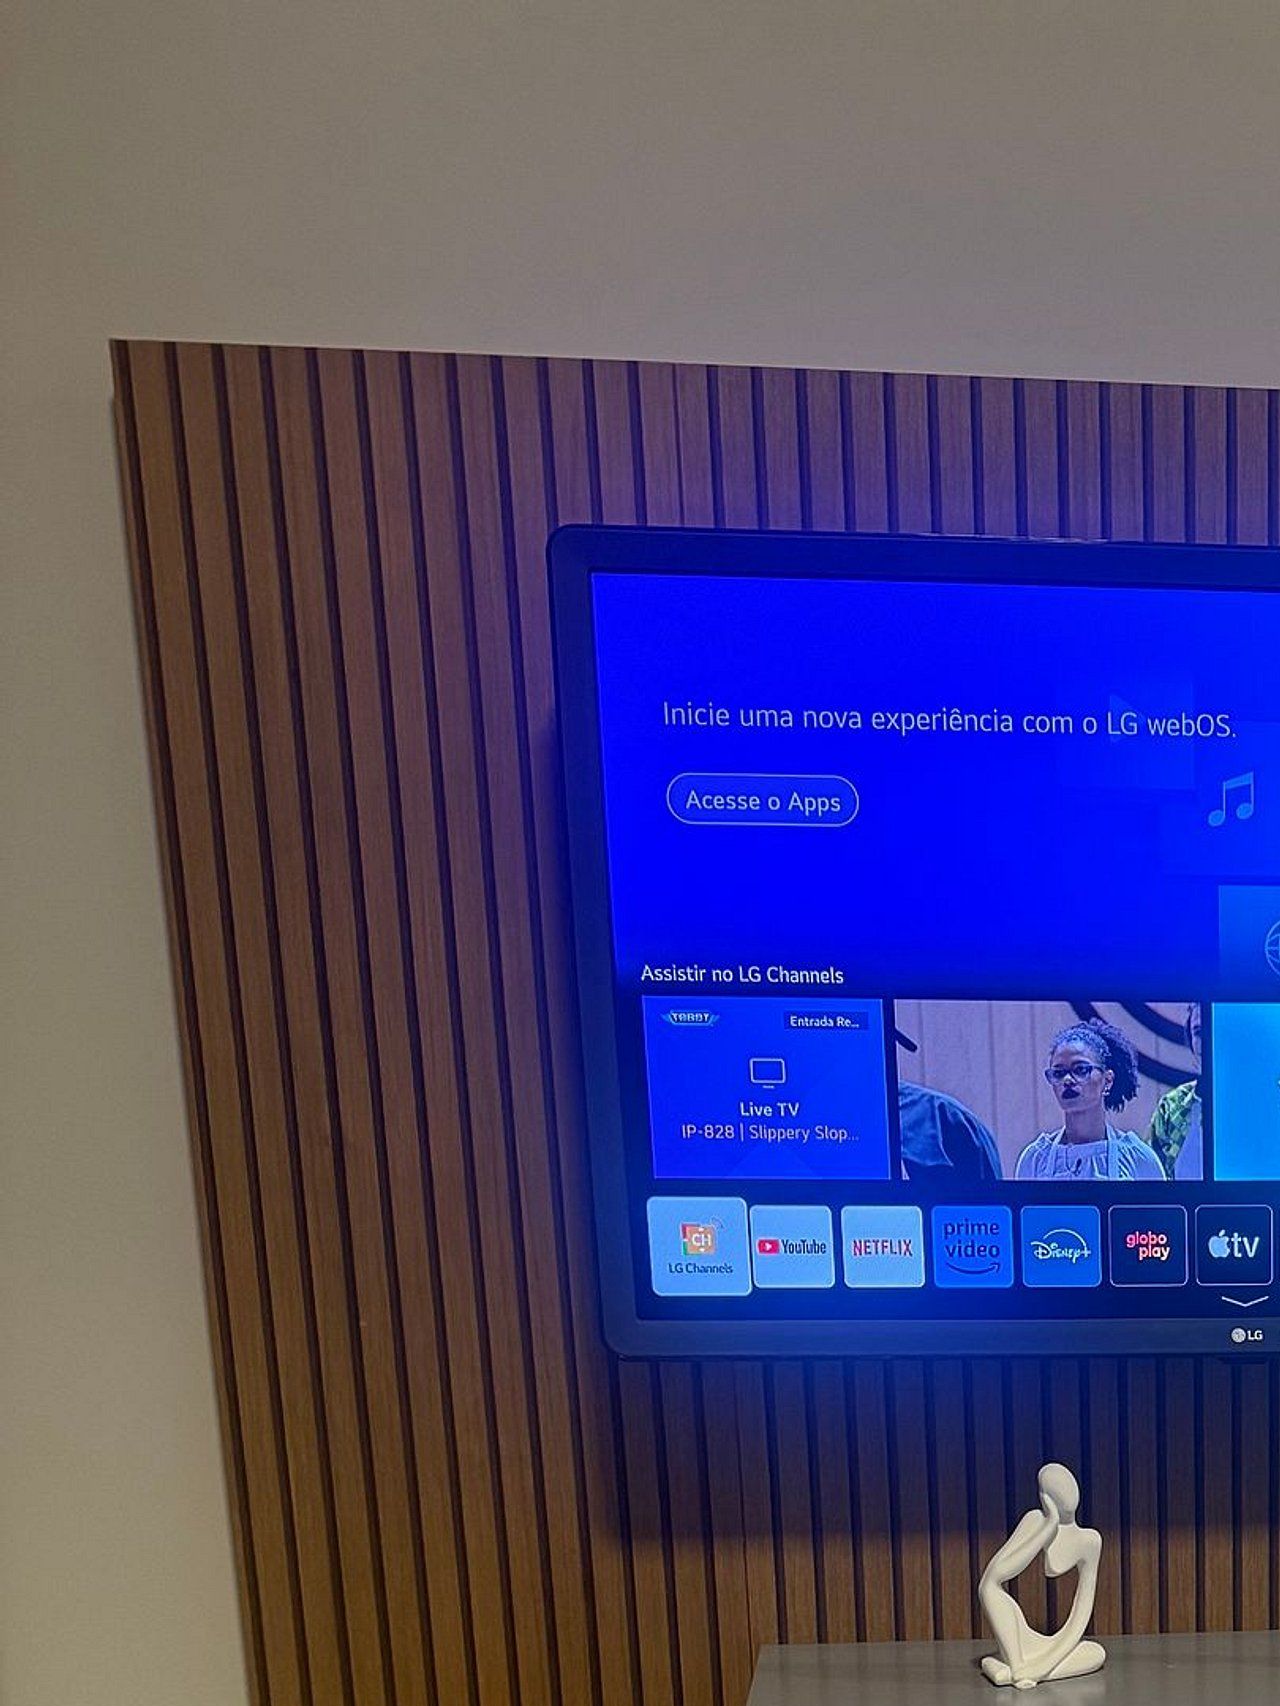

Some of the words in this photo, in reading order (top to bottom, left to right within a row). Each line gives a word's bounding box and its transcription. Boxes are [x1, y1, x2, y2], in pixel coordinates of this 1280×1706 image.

[663, 701, 730, 726] Inicie
[739, 708, 793, 728] uma
[803, 709, 862, 729] nova
[871, 707, 1014, 737] experiência
[1022, 714, 1073, 734] com
[1082, 716, 1098, 735] o
[1107, 711, 1138, 735] LG
[1147, 712, 1237, 738] webOS.
[685, 789, 761, 810] Acesse
[767, 795, 781, 811] o
[788, 791, 841, 817] Apps
[641, 964, 706, 983] Assistir
[712, 968, 734, 983] no
[739, 965, 762, 983] LG
[766, 965, 845, 985] Channels
[790, 1015, 834, 1028] Entrada
[740, 1101, 773, 1117] Live
[777, 1102, 800, 1117] TV
[681, 1124, 735, 1139] IP-828
[749, 1124, 811, 1143] Slippery
[943, 1219, 1000, 1242] prime
[1126, 1230, 1168, 1248] globo
[692, 1233, 712, 1247] CH
[780, 1239, 827, 1256] YouTube
[852, 1239, 913, 1257] NETFLIX
[1231, 1232, 1260, 1258] tv
[944, 1240, 1001, 1259] video
[1138, 1243, 1171, 1261] play
[668, 1262, 684, 1274] LG
[685, 1262, 734, 1275] Channels
[1247, 1329, 1264, 1341] LG
